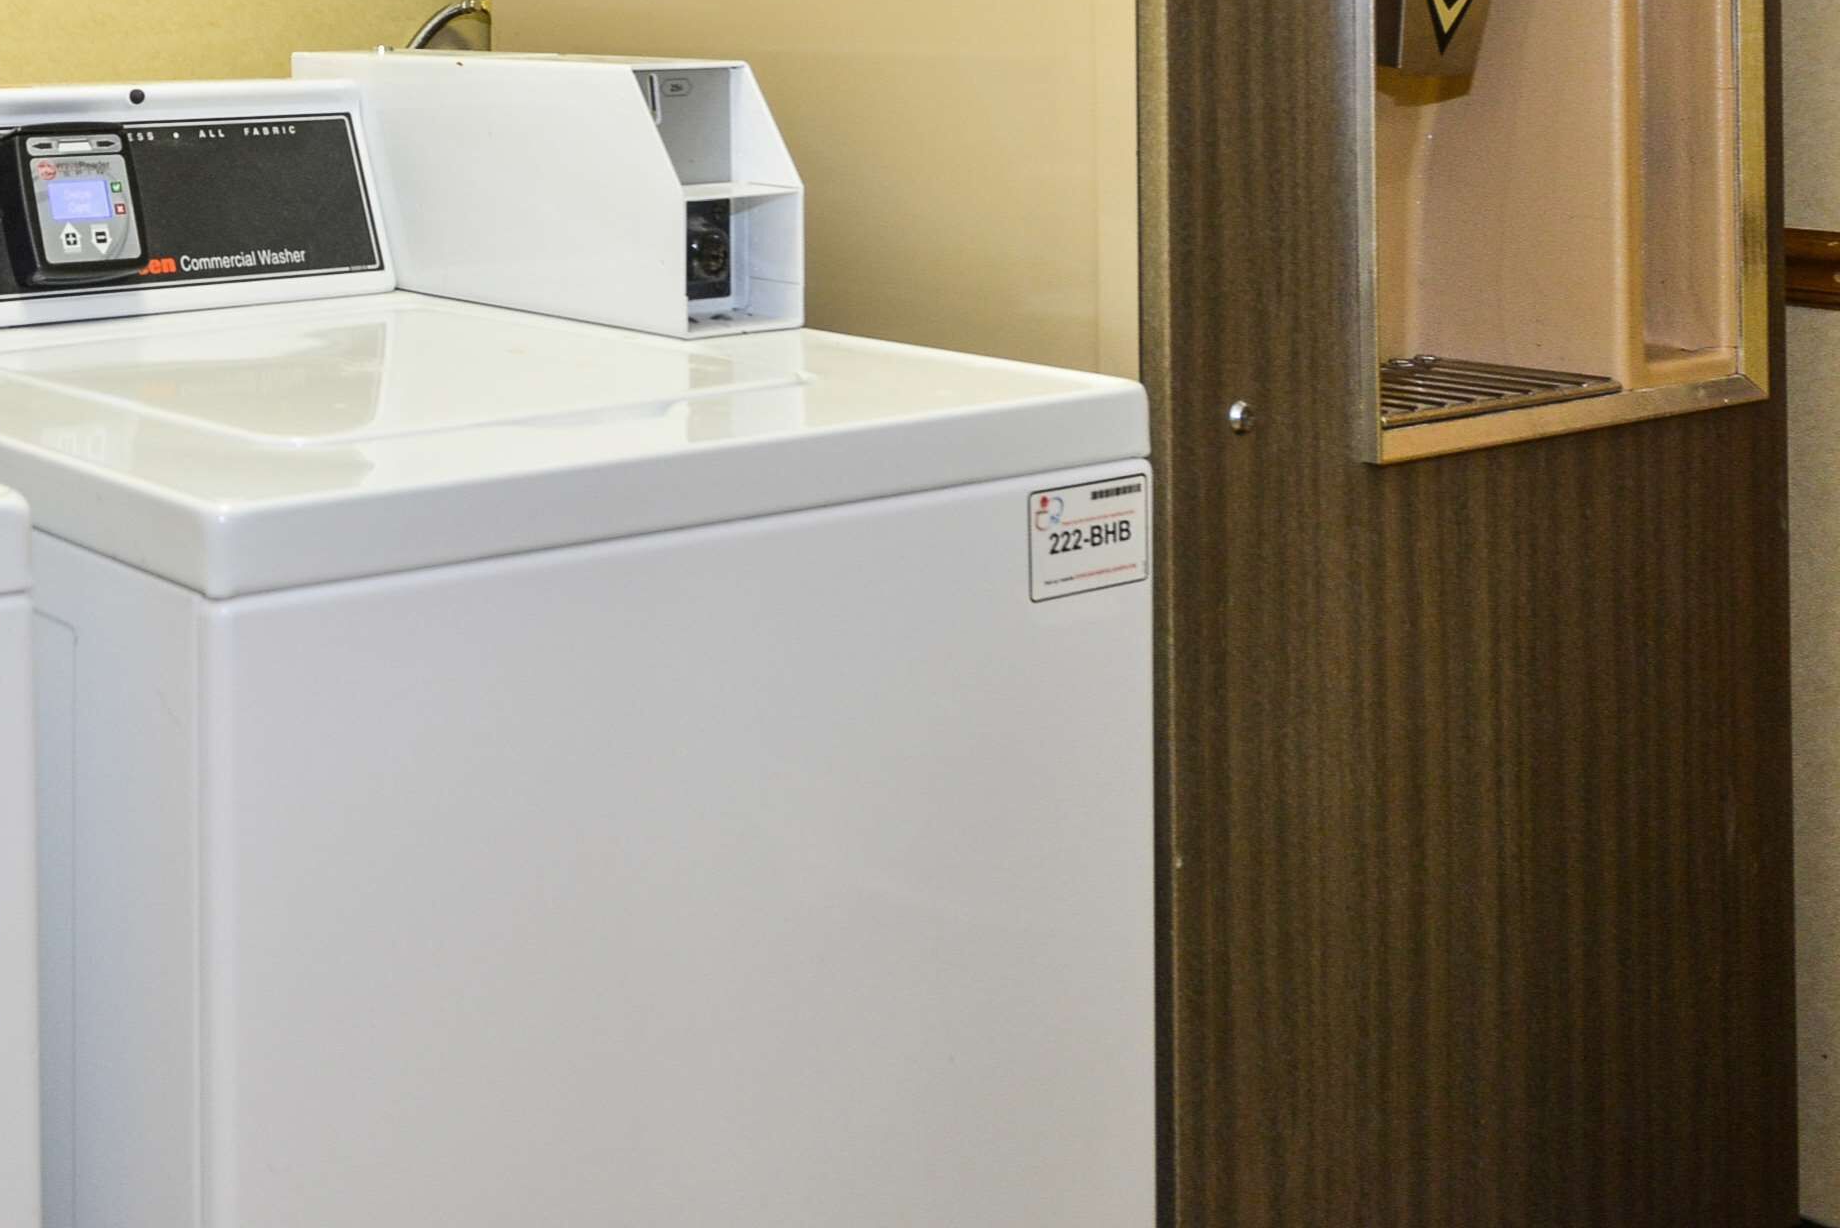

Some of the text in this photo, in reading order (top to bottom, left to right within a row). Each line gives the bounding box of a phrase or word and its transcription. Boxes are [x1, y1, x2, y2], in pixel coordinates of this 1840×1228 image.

[198, 128, 225, 139] ALL
[243, 124, 297, 137] FABRIC
[180, 251, 256, 272] Commercial
[257, 248, 306, 266] Washer
[1048, 519, 1132, 556] 222-BHB
